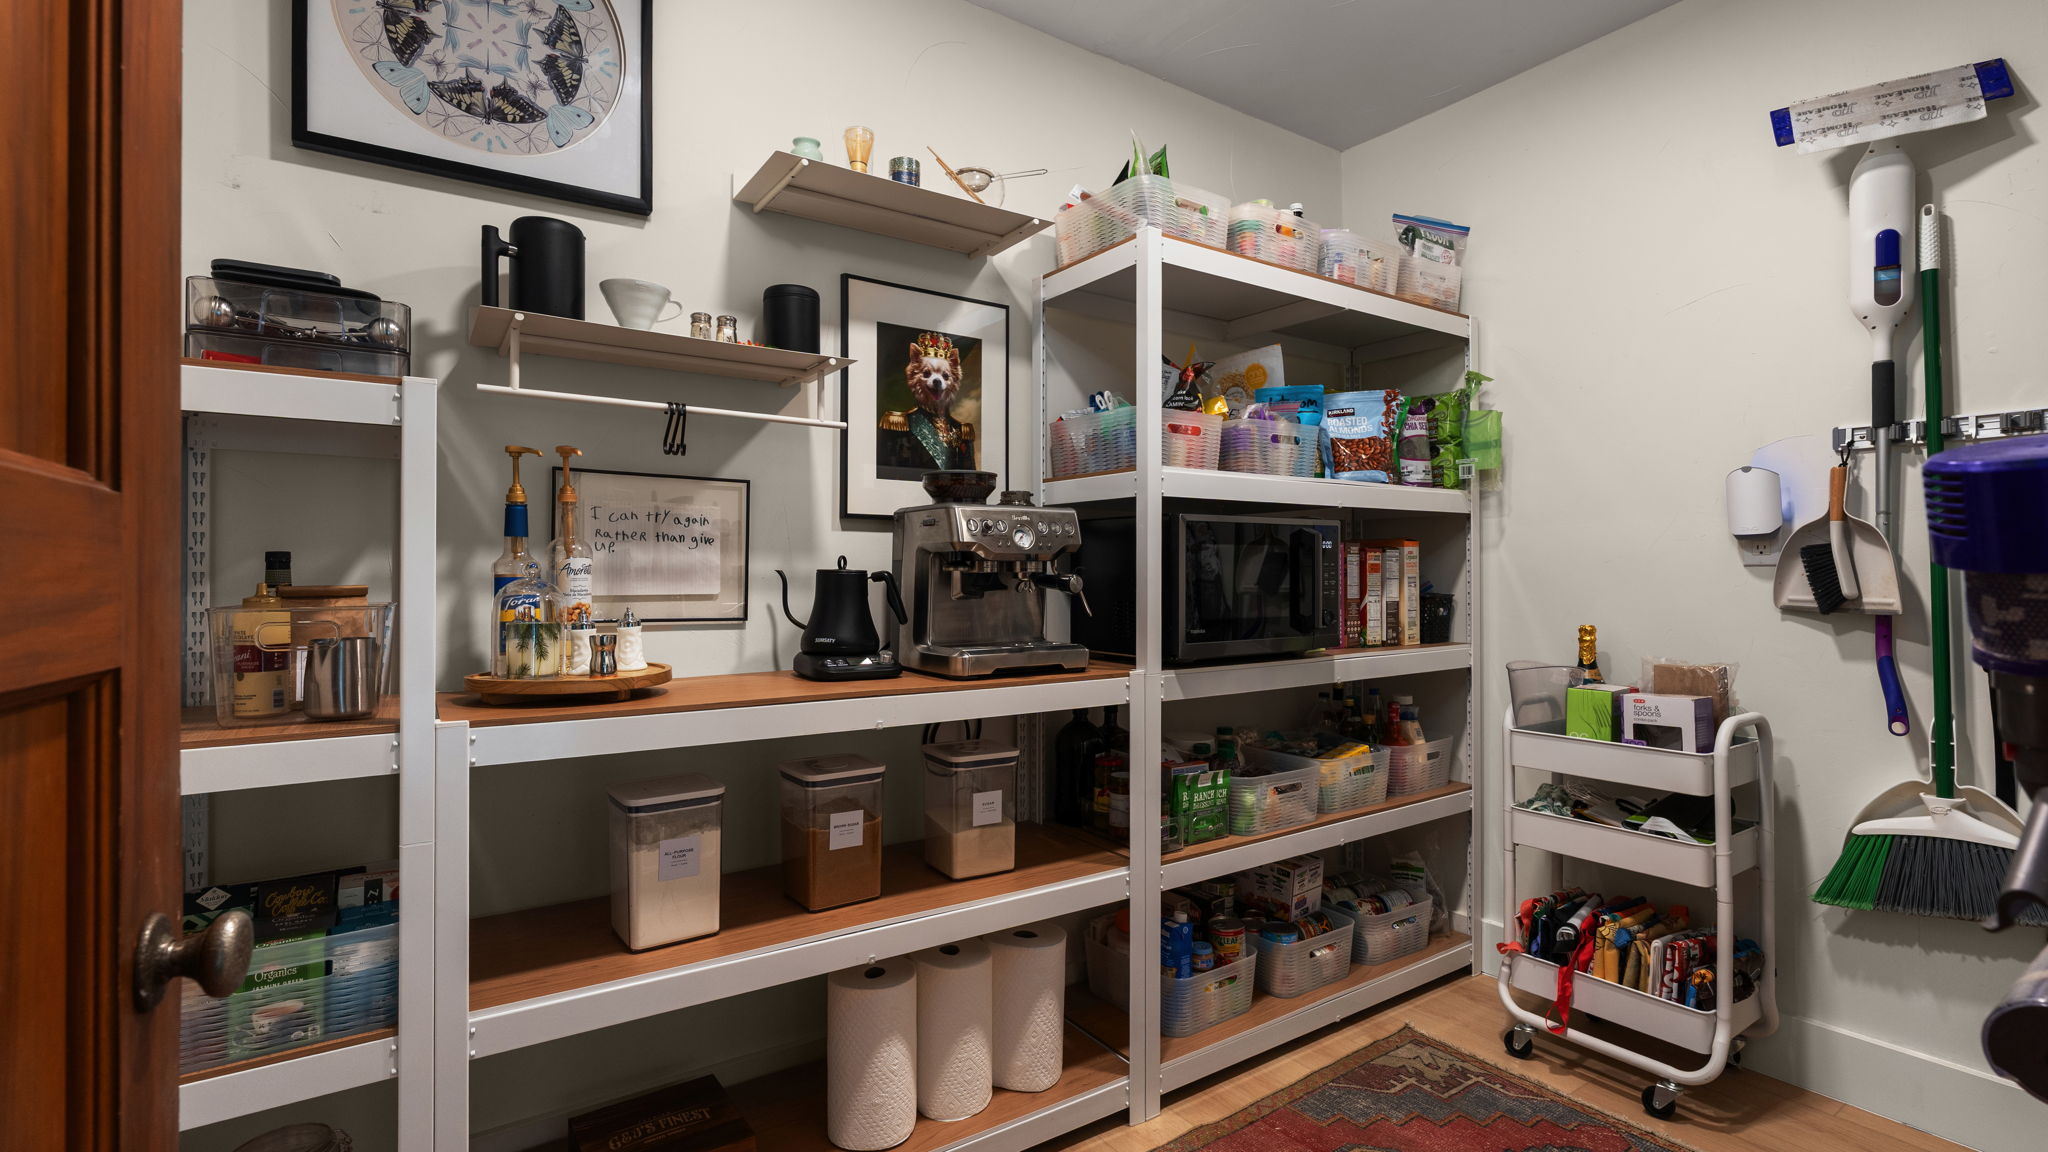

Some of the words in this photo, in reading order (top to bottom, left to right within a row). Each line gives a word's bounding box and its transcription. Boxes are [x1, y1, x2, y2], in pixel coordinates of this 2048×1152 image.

[1328, 408, 1354, 416] KIRKLAND
[1327, 416, 1368, 426] ROASTED
[1328, 424, 1373, 432] ALMONDS
[590, 506, 602, 520] I
[609, 510, 638, 522] can
[646, 509, 671, 524] try
[674, 514, 710, 528] again
[656, 532, 685, 543] than
[688, 534, 714, 550] give
[1633, 710, 1662, 718] spoons
[664, 848, 694, 856] ALL-PURPOSE
[254, 966, 298, 982] Organics
[658, 1107, 712, 1129] FINEST
